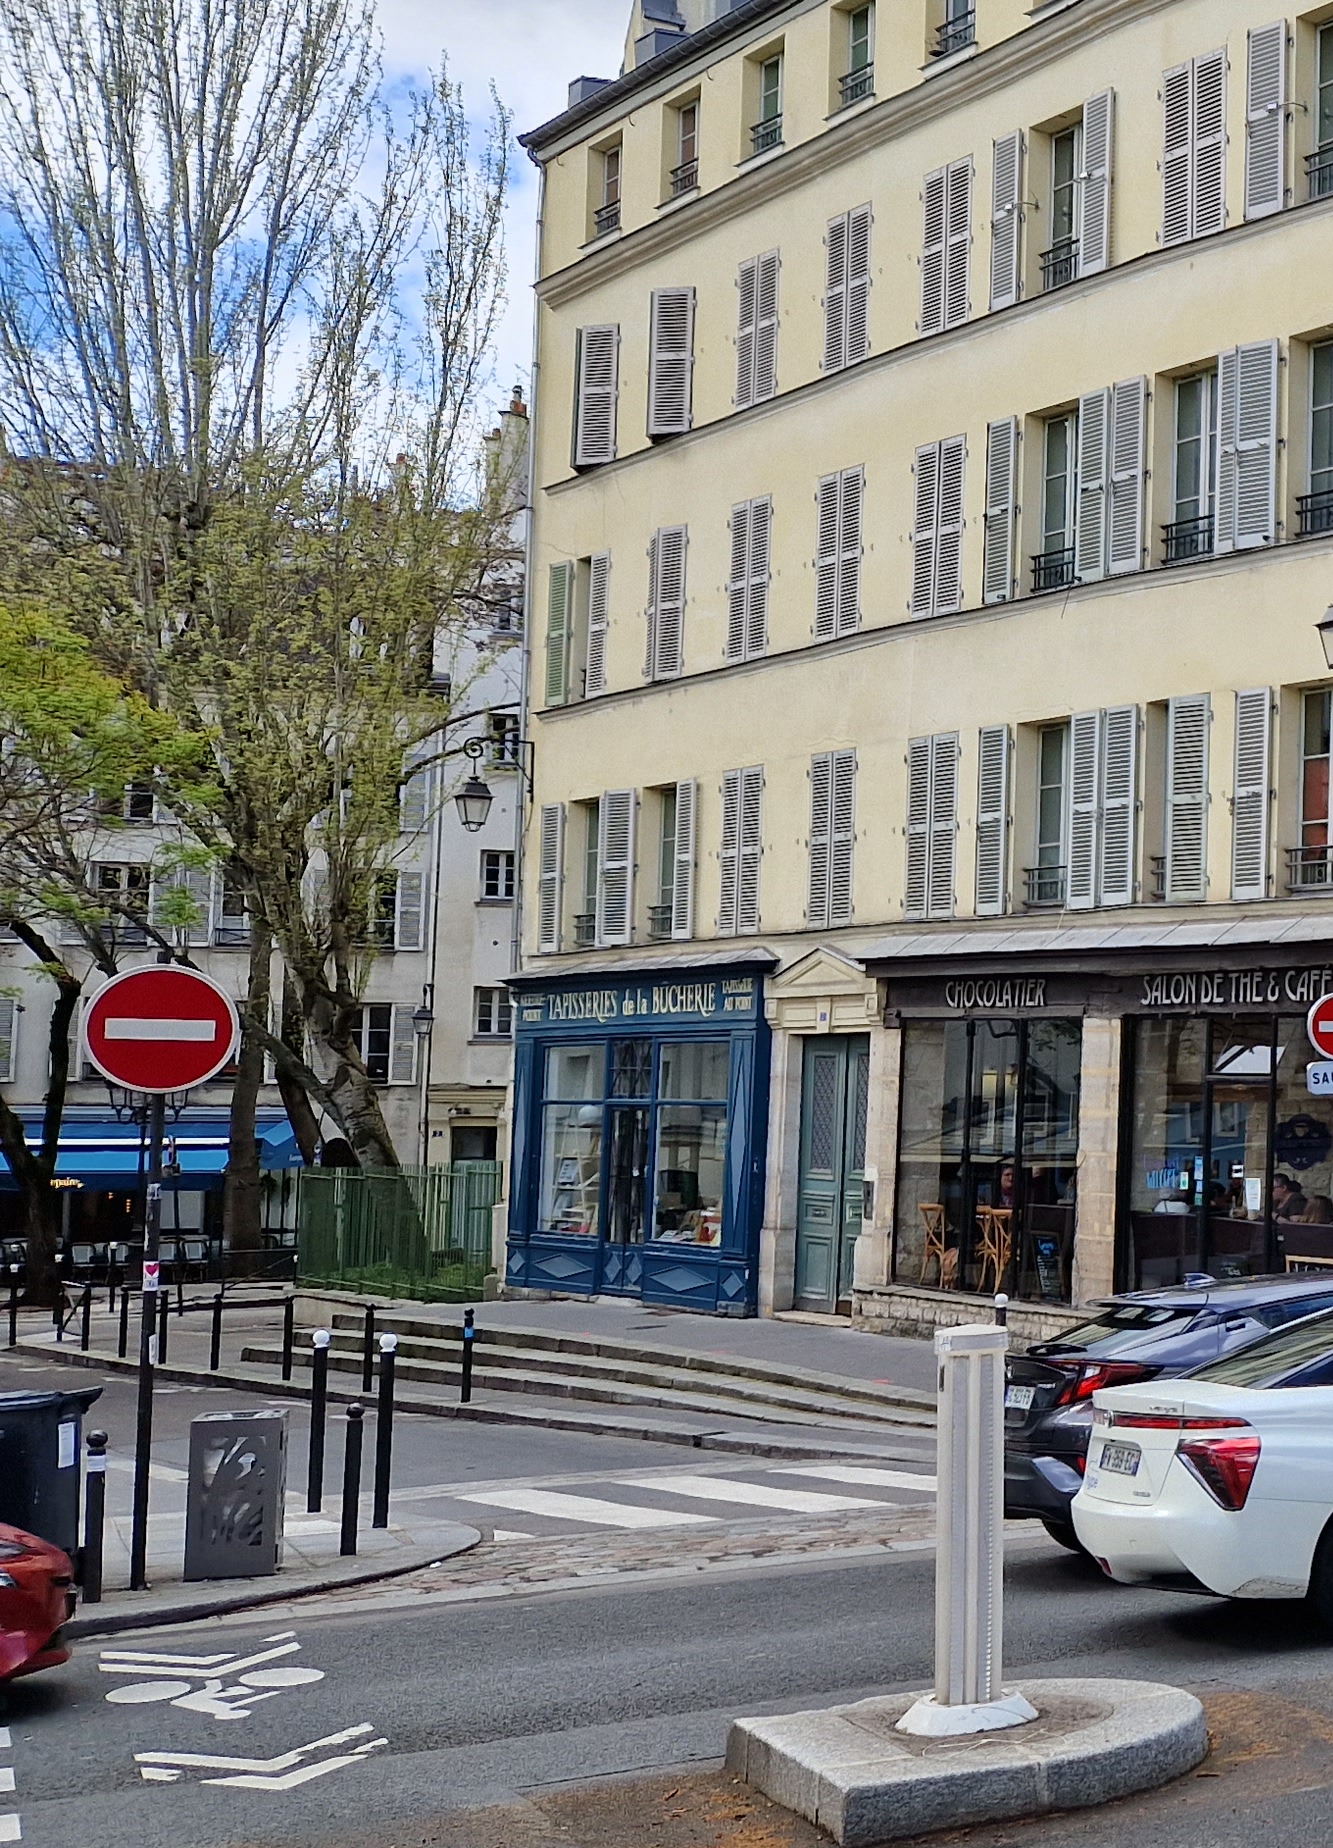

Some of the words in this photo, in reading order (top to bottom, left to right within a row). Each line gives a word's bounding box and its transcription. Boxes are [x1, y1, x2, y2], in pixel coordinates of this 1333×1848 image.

[945, 979, 1046, 1008] CHOCOLATIER
[1140, 974, 1197, 1005] SALON
[1201, 973, 1225, 1003] DE
[1267, 971, 1280, 1001] &
[1284, 963, 1332, 1002] CAFÉ
[547, 990, 618, 1022] TAPISSERIES
[622, 988, 634, 1015] de
[637, 988, 648, 1014] la
